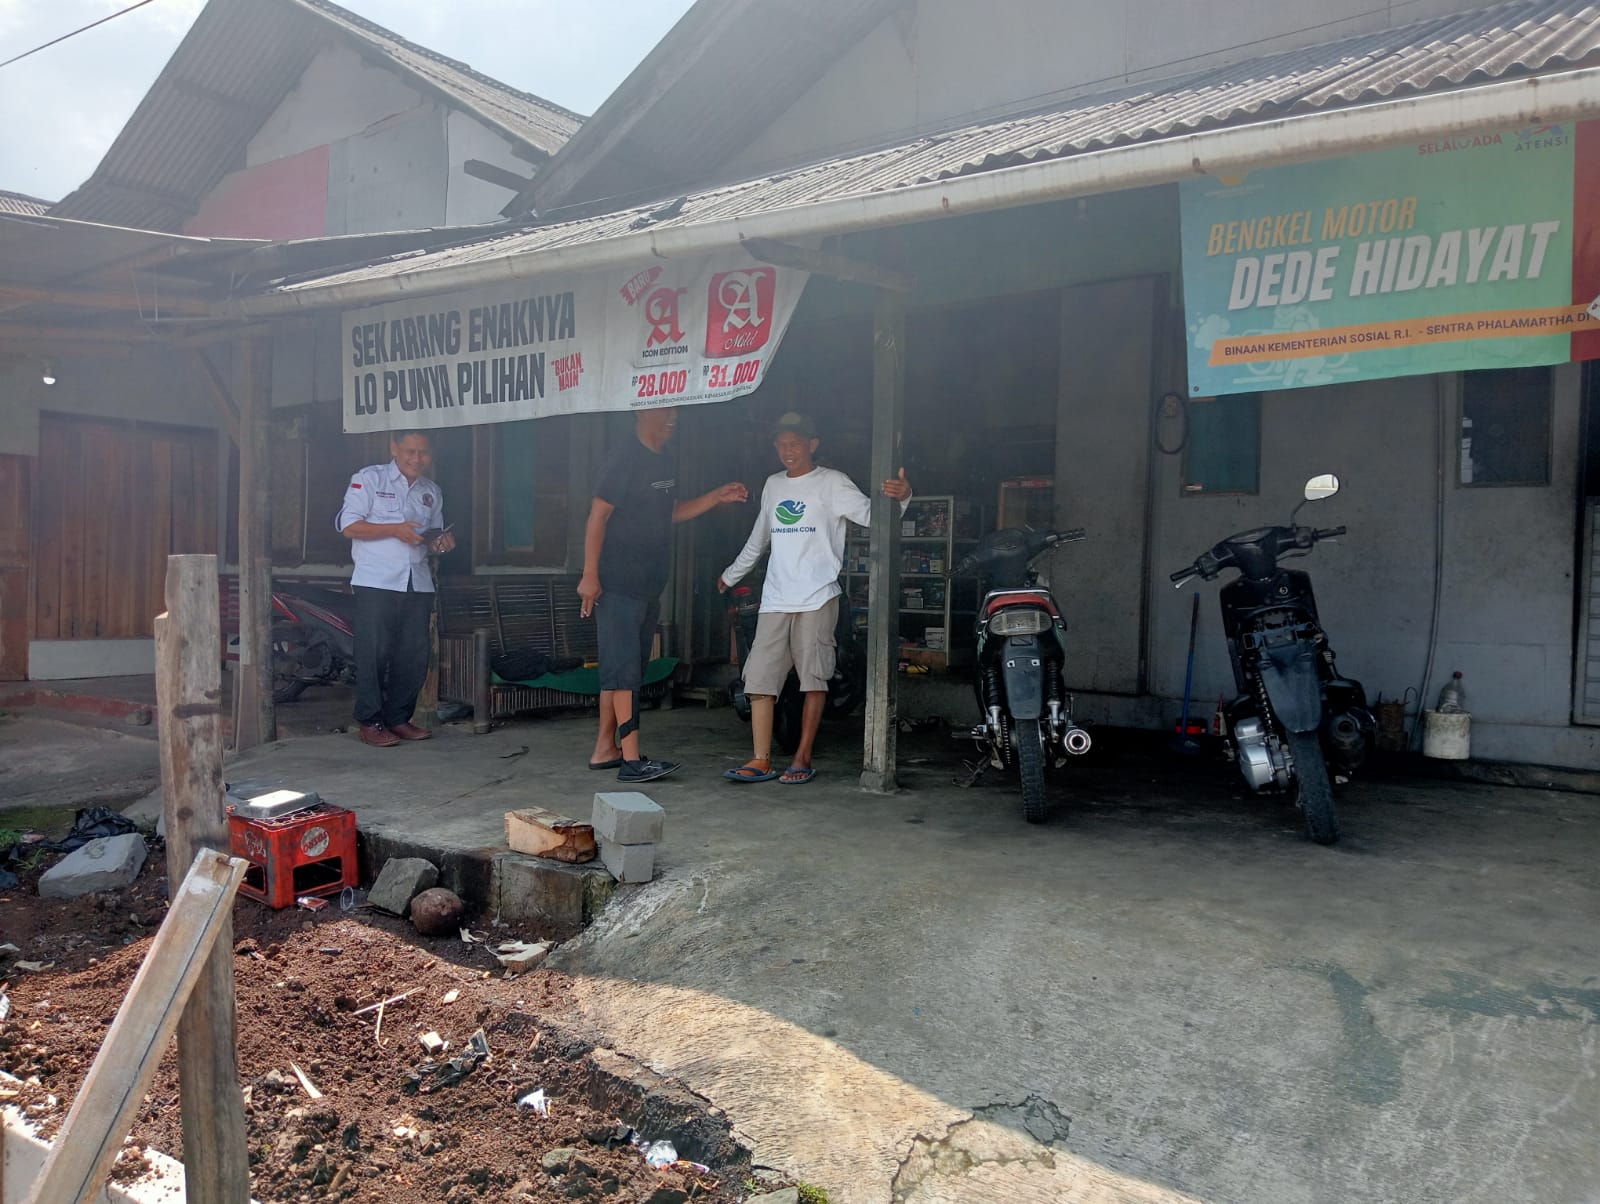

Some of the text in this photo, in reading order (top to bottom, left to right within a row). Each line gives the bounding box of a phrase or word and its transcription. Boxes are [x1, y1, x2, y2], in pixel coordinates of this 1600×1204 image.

[1515, 135, 1568, 152] ATENSI
[1207, 197, 1417, 256] BENGKEL MOTOR
[1228, 220, 1560, 310] DEDE HIDAYAT
[352, 291, 576, 368] SEKARANG ENAKNYA
[1224, 343, 1266, 356] BINAAN
[1268, 335, 1347, 352] KEMENTERIAN
[1350, 330, 1391, 343] SOSIAL
[1426, 319, 1474, 335] SENTRA
[1477, 314, 1574, 330] PHALAMARTHA
[642, 345, 688, 358] ICON EDITION
[354, 352, 545, 416] LO PUNYA PILIHAN
[638, 370, 687, 398] 28.000
[708, 360, 761, 389] 31.000
